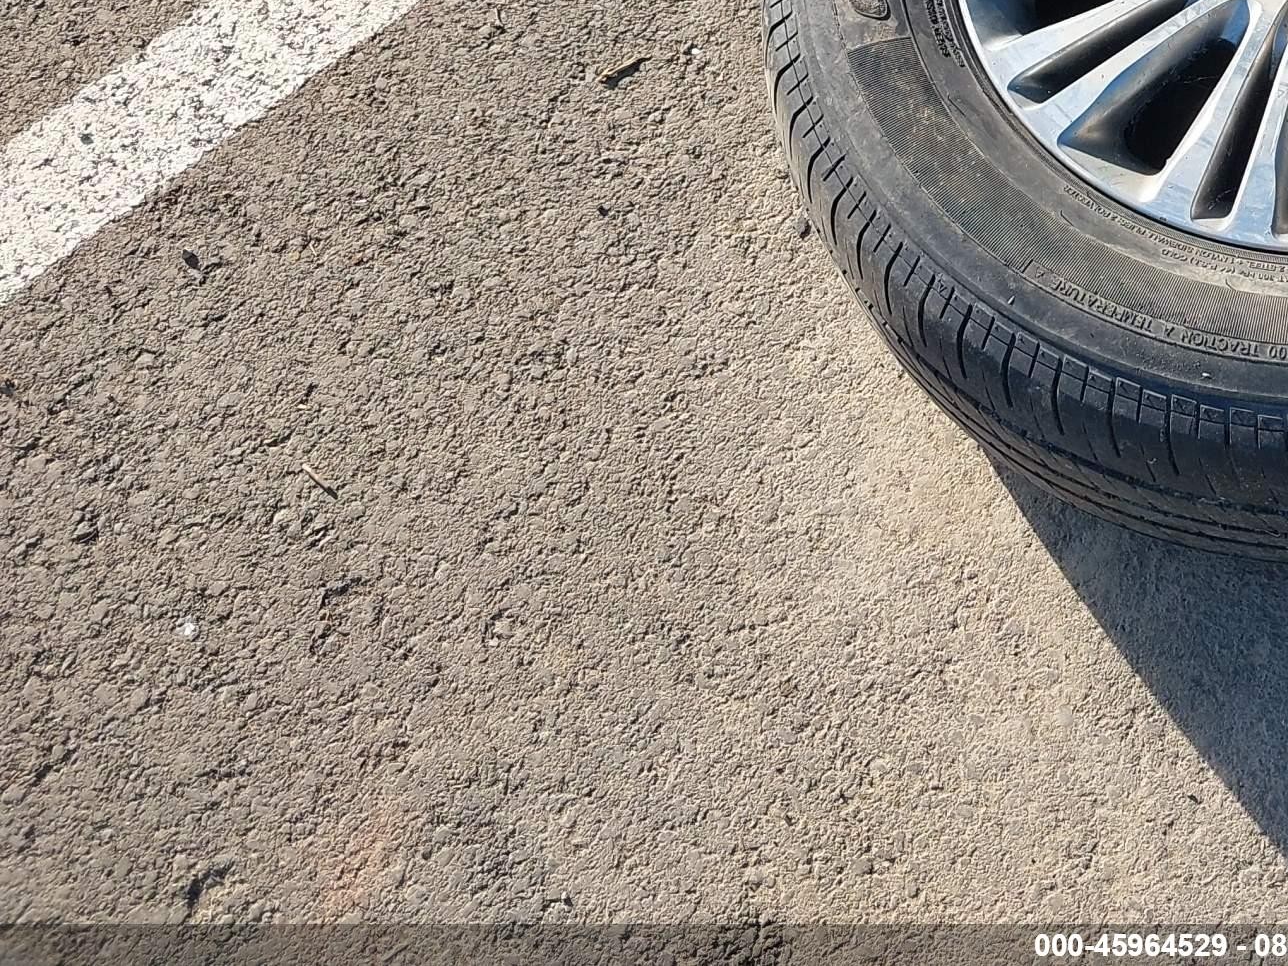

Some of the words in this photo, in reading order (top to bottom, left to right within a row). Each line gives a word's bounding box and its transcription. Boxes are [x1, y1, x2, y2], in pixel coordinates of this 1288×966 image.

[1028, 264, 1050, 283] A
[1051, 277, 1154, 333] TEMPERATURE
[1158, 322, 1174, 340] A
[1179, 331, 1260, 358] TRACTION
